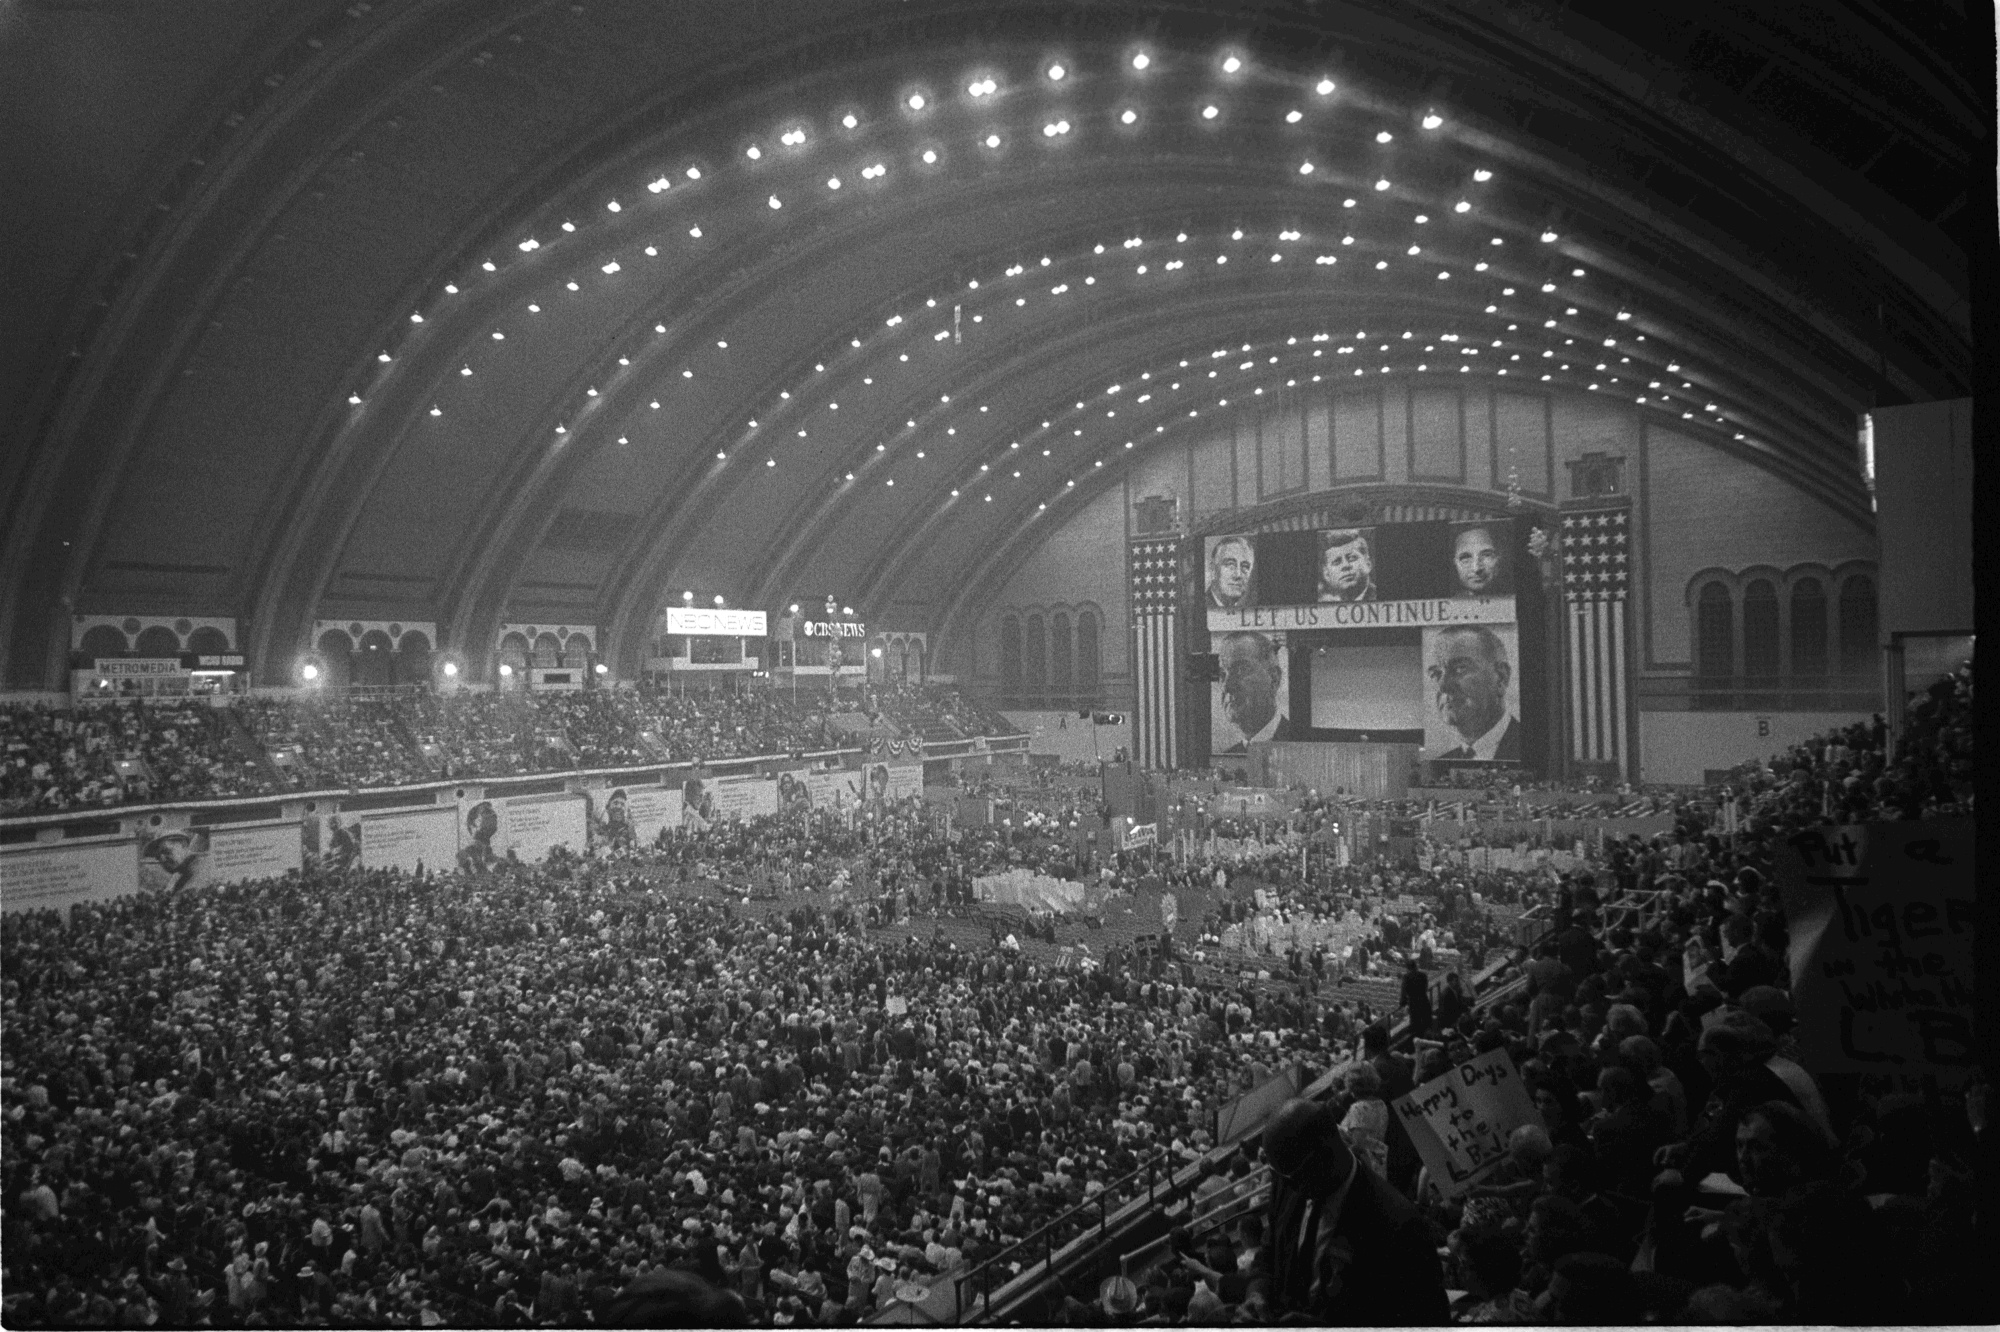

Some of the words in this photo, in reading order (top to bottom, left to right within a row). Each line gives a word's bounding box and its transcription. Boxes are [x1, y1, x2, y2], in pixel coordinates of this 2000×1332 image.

[671, 614, 710, 629] NBC
[715, 614, 764, 631] NEWS
[1295, 607, 1319, 626] US
[100, 662, 176, 675] METROMEDIA
[1758, 720, 1769, 736] B
[1788, 830, 1857, 867] Put
[1400, 1086, 1457, 1120] Happy
[1461, 1064, 1507, 1086] Days
[1449, 1109, 1474, 1126] to
[1448, 1121, 1490, 1151] the
